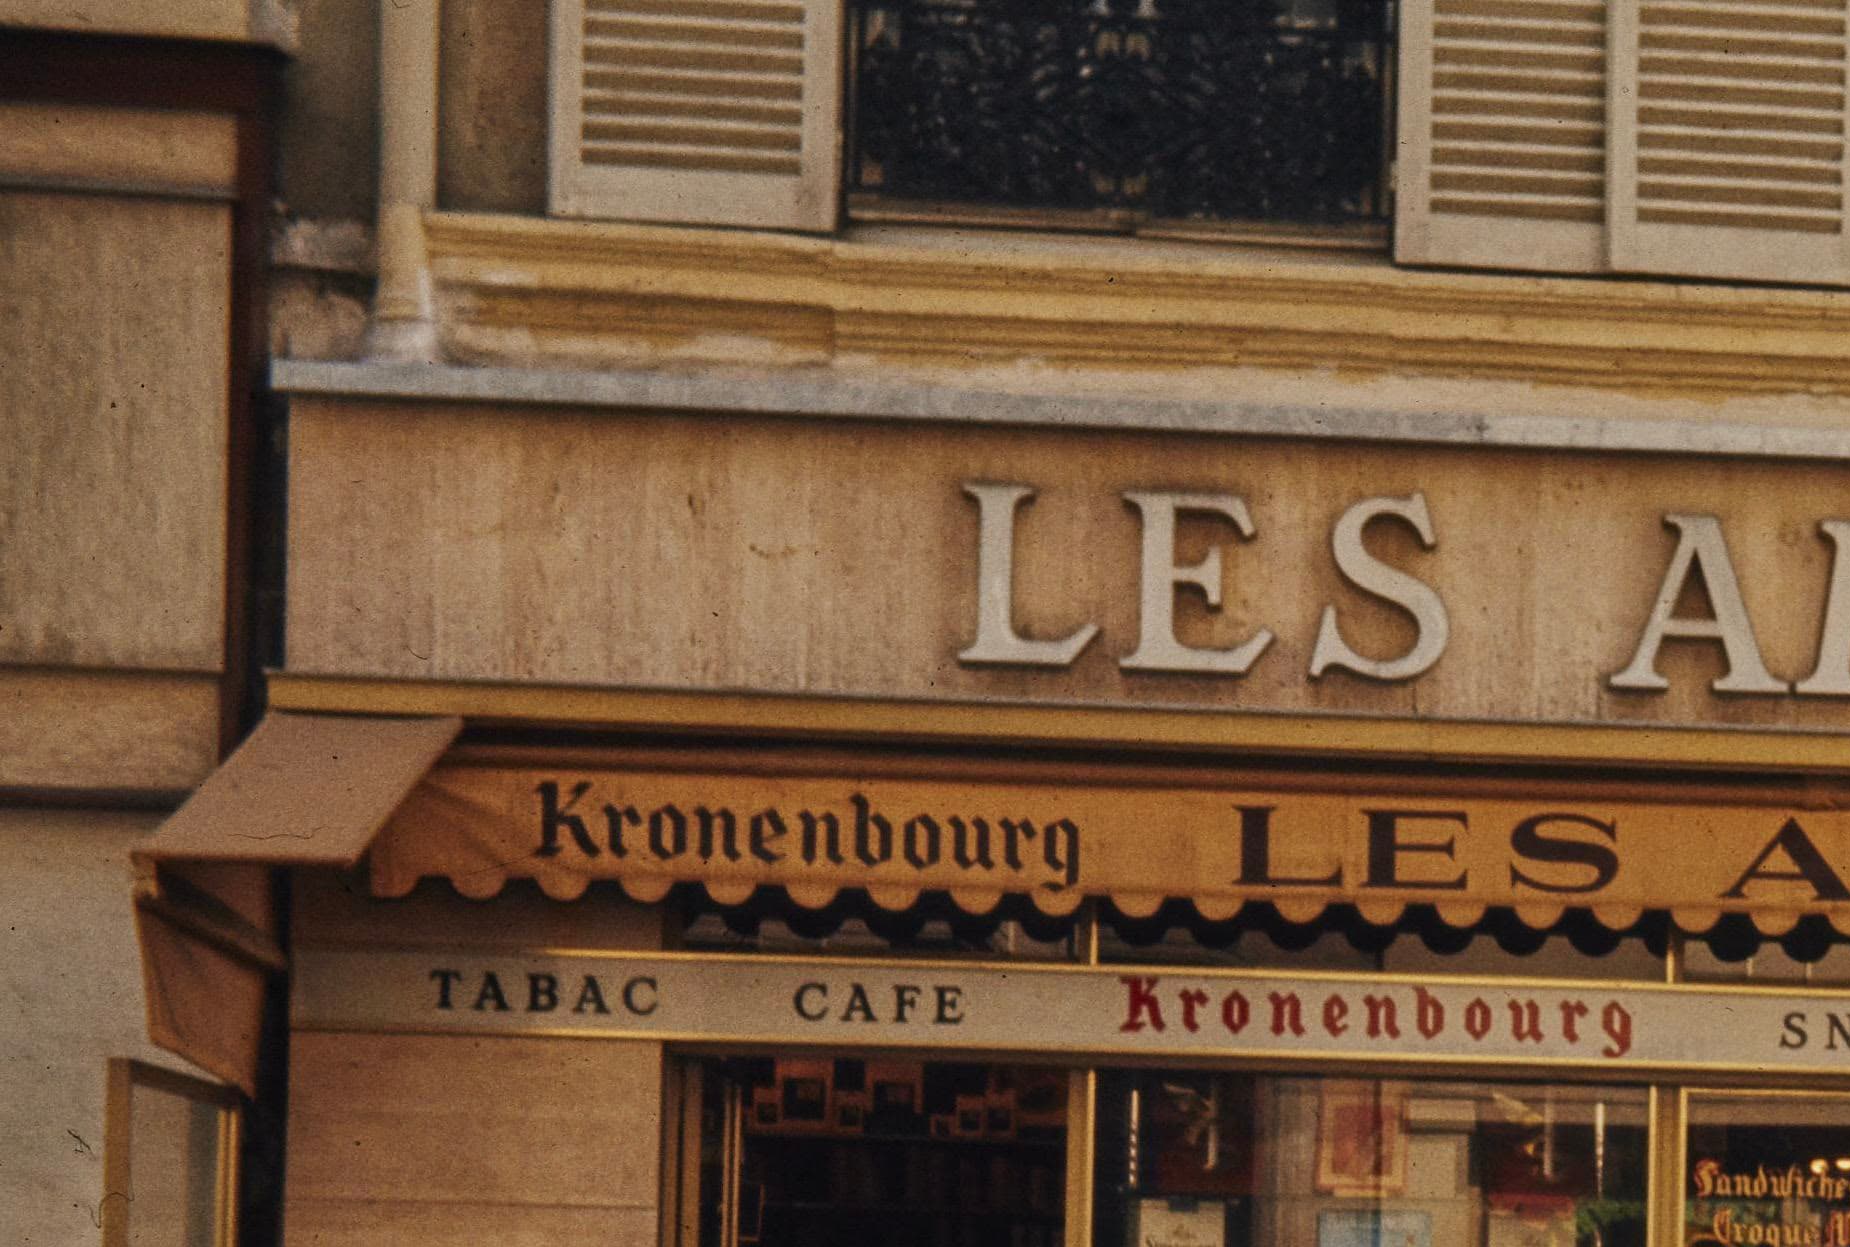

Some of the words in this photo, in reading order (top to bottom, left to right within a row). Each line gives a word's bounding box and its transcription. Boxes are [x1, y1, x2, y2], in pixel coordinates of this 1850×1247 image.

[957, 481, 1451, 681] LES
[532, 779, 1083, 890] Kronenbourg
[1232, 805, 1622, 895] LES
[429, 969, 660, 1017] TABAC
[794, 983, 967, 1024] CAFE
[1117, 974, 1635, 1059] Kronenbourg
